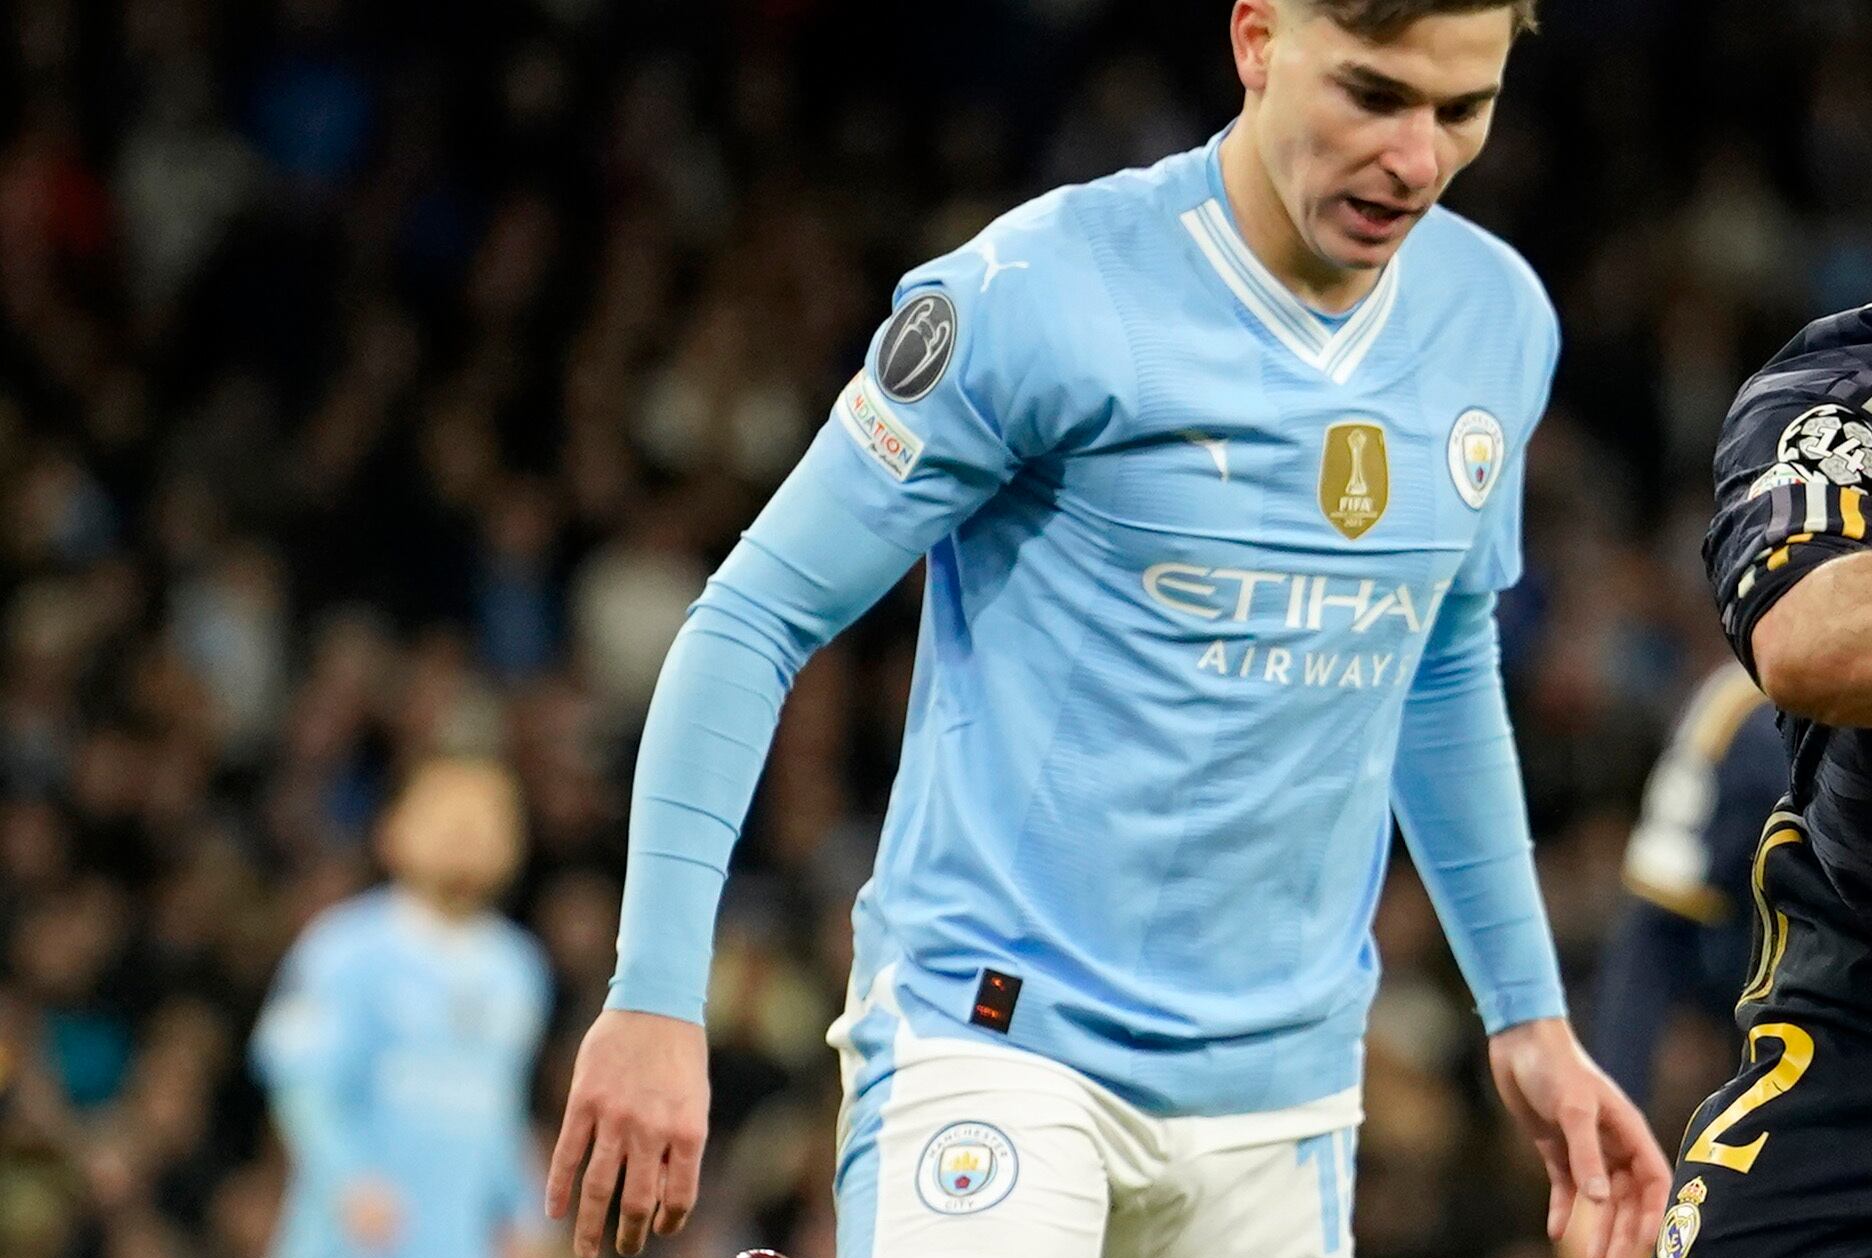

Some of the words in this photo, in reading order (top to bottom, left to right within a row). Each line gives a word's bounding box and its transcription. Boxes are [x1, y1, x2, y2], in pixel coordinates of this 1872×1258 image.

[1806, 428, 1866, 473] 14
[1339, 496, 1372, 512] FIFA
[1685, 1022, 1815, 1174] 2
